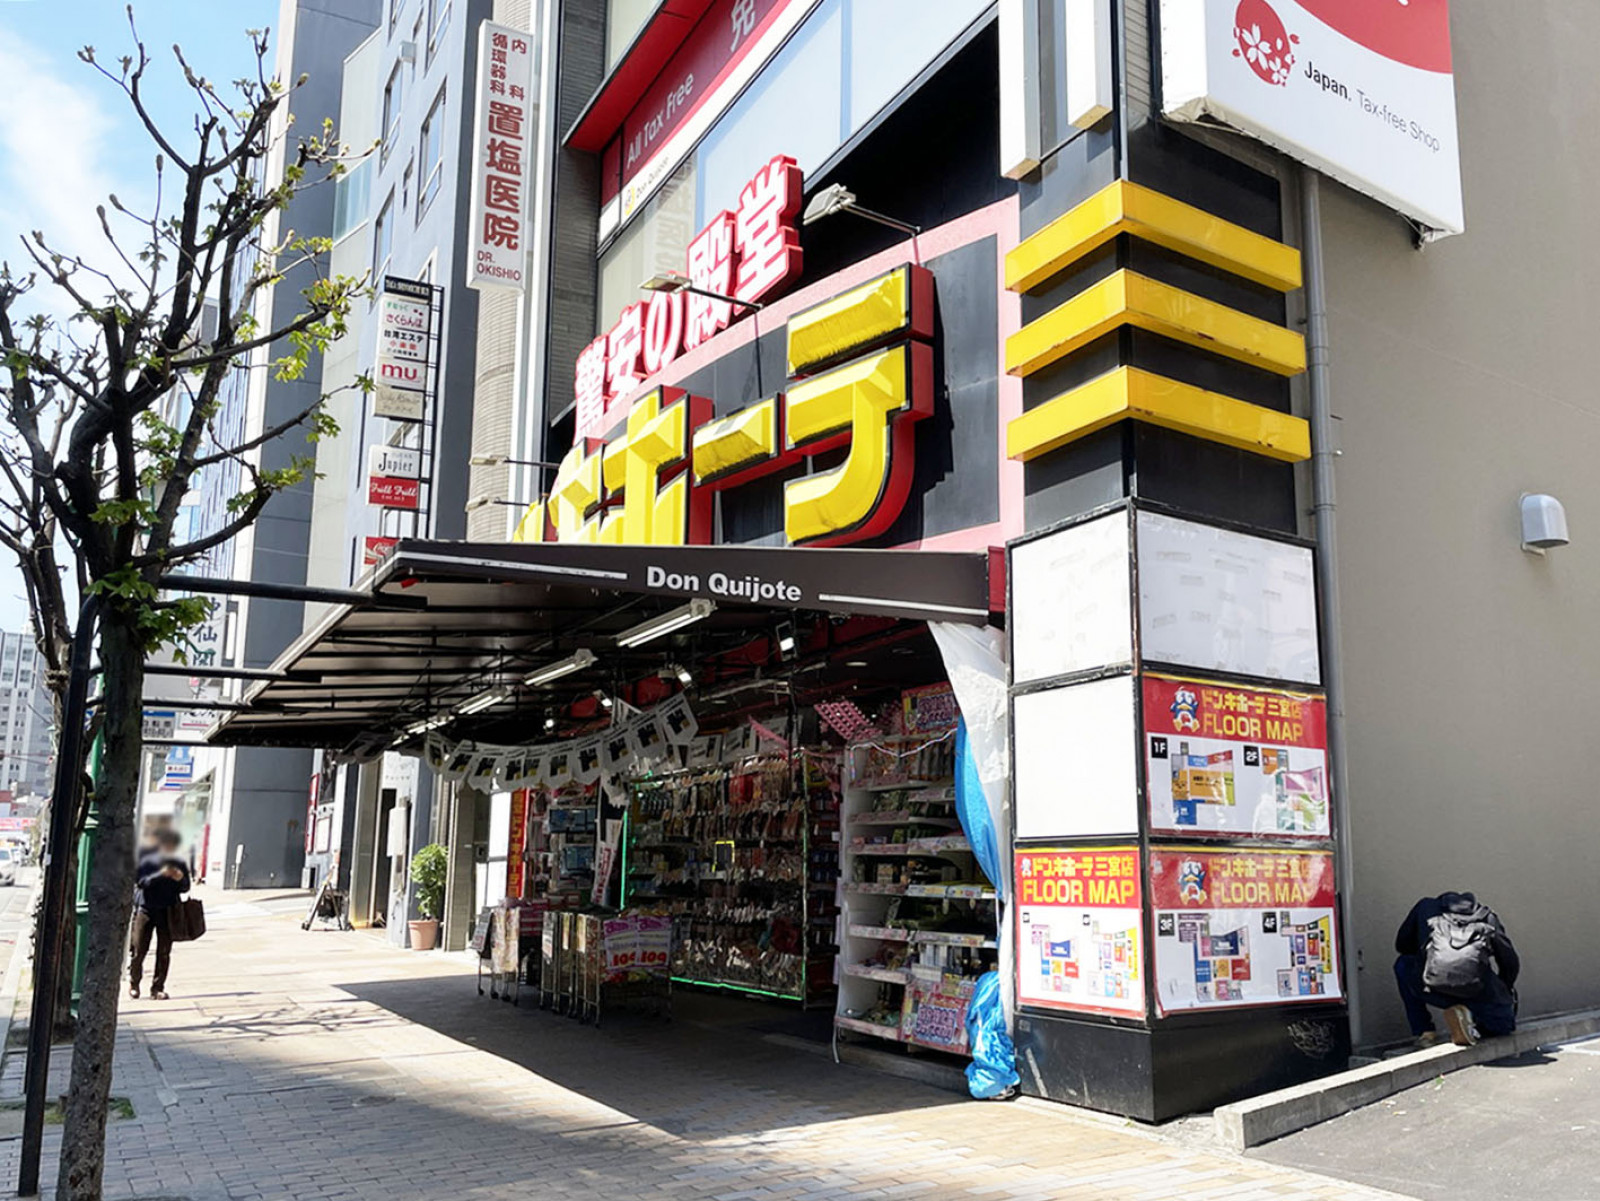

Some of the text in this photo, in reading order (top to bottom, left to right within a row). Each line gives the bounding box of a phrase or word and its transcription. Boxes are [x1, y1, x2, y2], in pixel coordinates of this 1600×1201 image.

[509, 38, 527, 102] 内科
[644, 110, 664, 148] Tax
[666, 73, 694, 121] Free
[1356, 89, 1407, 134] Tax-free
[1409, 121, 1440, 154] Shop
[484, 100, 524, 251] 置塩医院
[476, 262, 522, 281] OKISHIO
[477, 250, 496, 265] DR.
[573, 155, 796, 448] 驚安の殿堂
[381, 364, 417, 381] mu
[647, 566, 802, 602] Don Quijote
[1203, 713, 1303, 742] FLOOR MAP
[1154, 741, 1166, 754] 1F
[1023, 879, 1136, 904] FLOOR MAP
[1211, 879, 1271, 904] FLOOR
